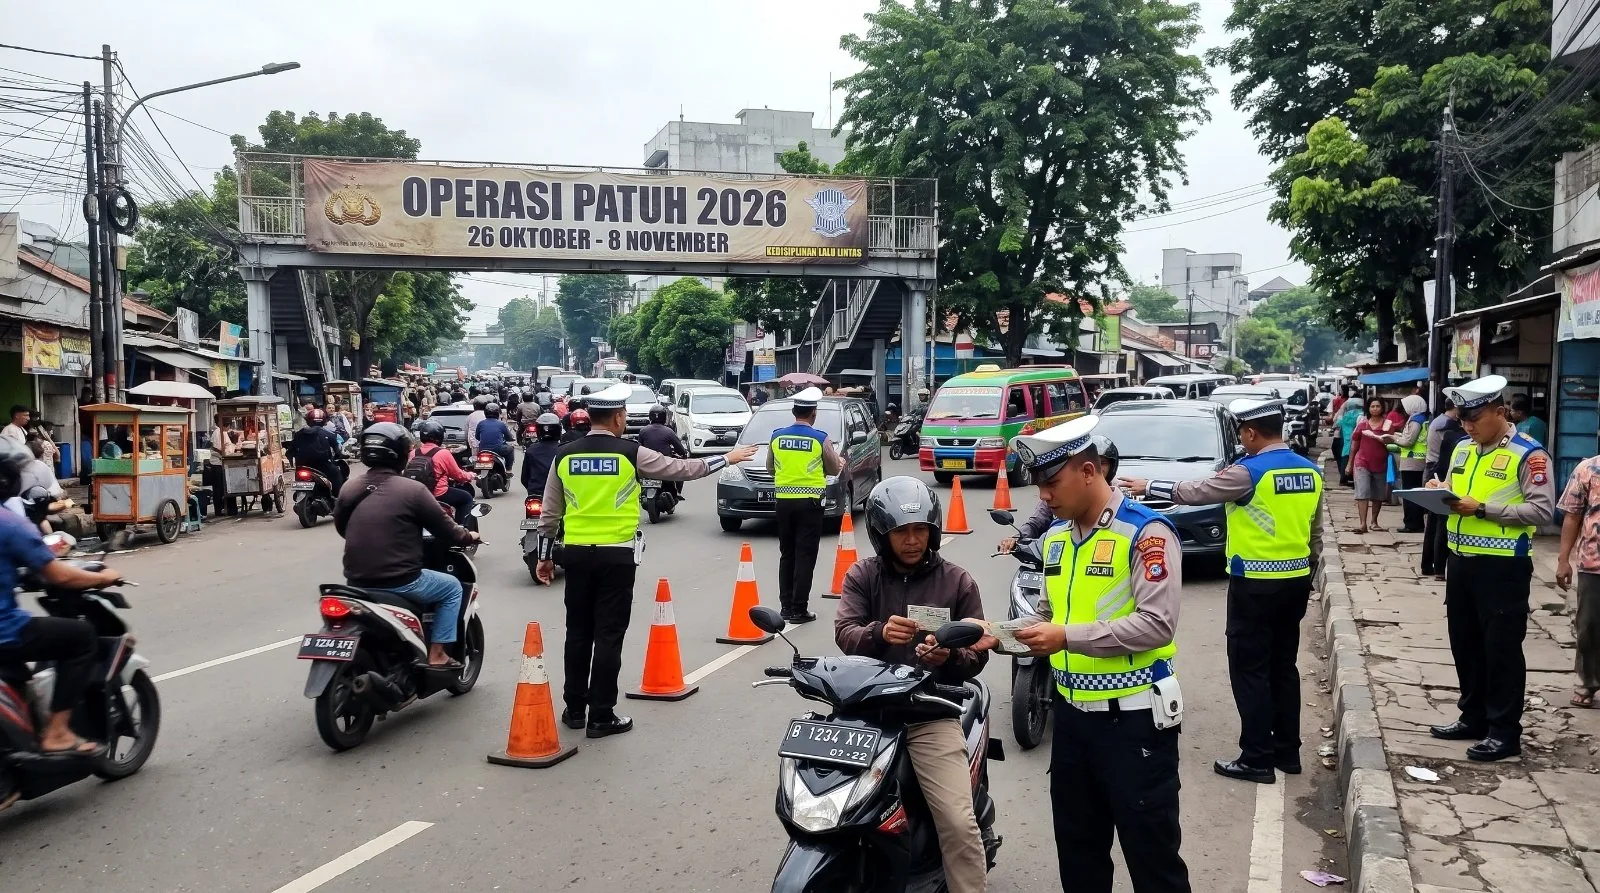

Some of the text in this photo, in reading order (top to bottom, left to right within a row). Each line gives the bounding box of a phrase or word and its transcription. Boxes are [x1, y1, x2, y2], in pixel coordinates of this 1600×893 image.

[402, 176, 787, 228] OPERASI PATUH 2026
[467, 226, 495, 248] 26
[499, 227, 591, 250] OKTOBER
[608, 229, 621, 251] 8
[626, 230, 729, 253] NOVEMBER
[766, 246, 863, 258] KEDISIPLINAN LALU LINTAS
[779, 439, 811, 450] POLISI
[571, 459, 617, 473] POLISI
[1275, 474, 1314, 491] POLISI
[791, 724, 874, 749] B 1234 XYZ
